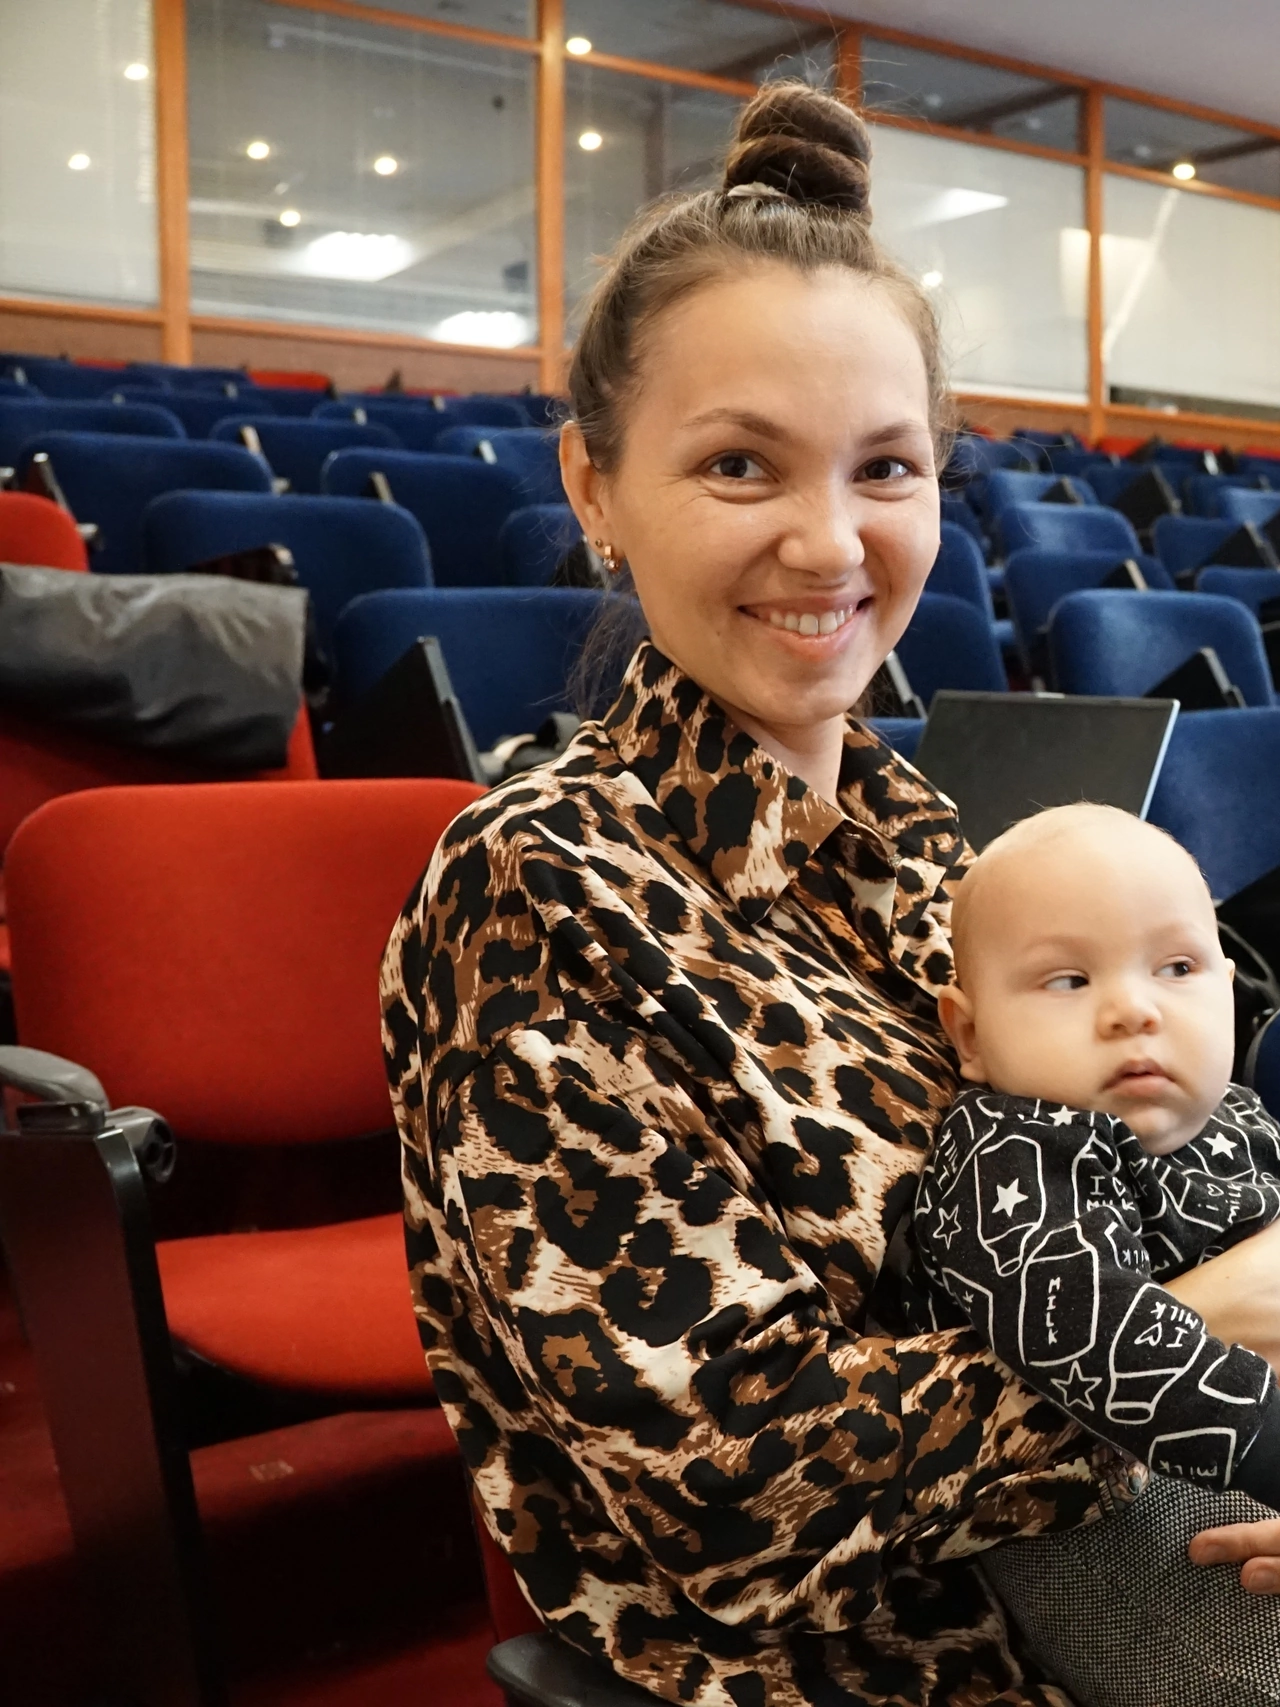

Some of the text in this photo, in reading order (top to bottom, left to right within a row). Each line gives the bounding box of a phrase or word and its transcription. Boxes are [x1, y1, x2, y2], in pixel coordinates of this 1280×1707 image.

[1089, 1175, 1106, 1196] I
[1044, 1276, 1061, 1346] MILK
[1150, 1300, 1199, 1330] MILK
[1165, 1326, 1189, 1348] I
